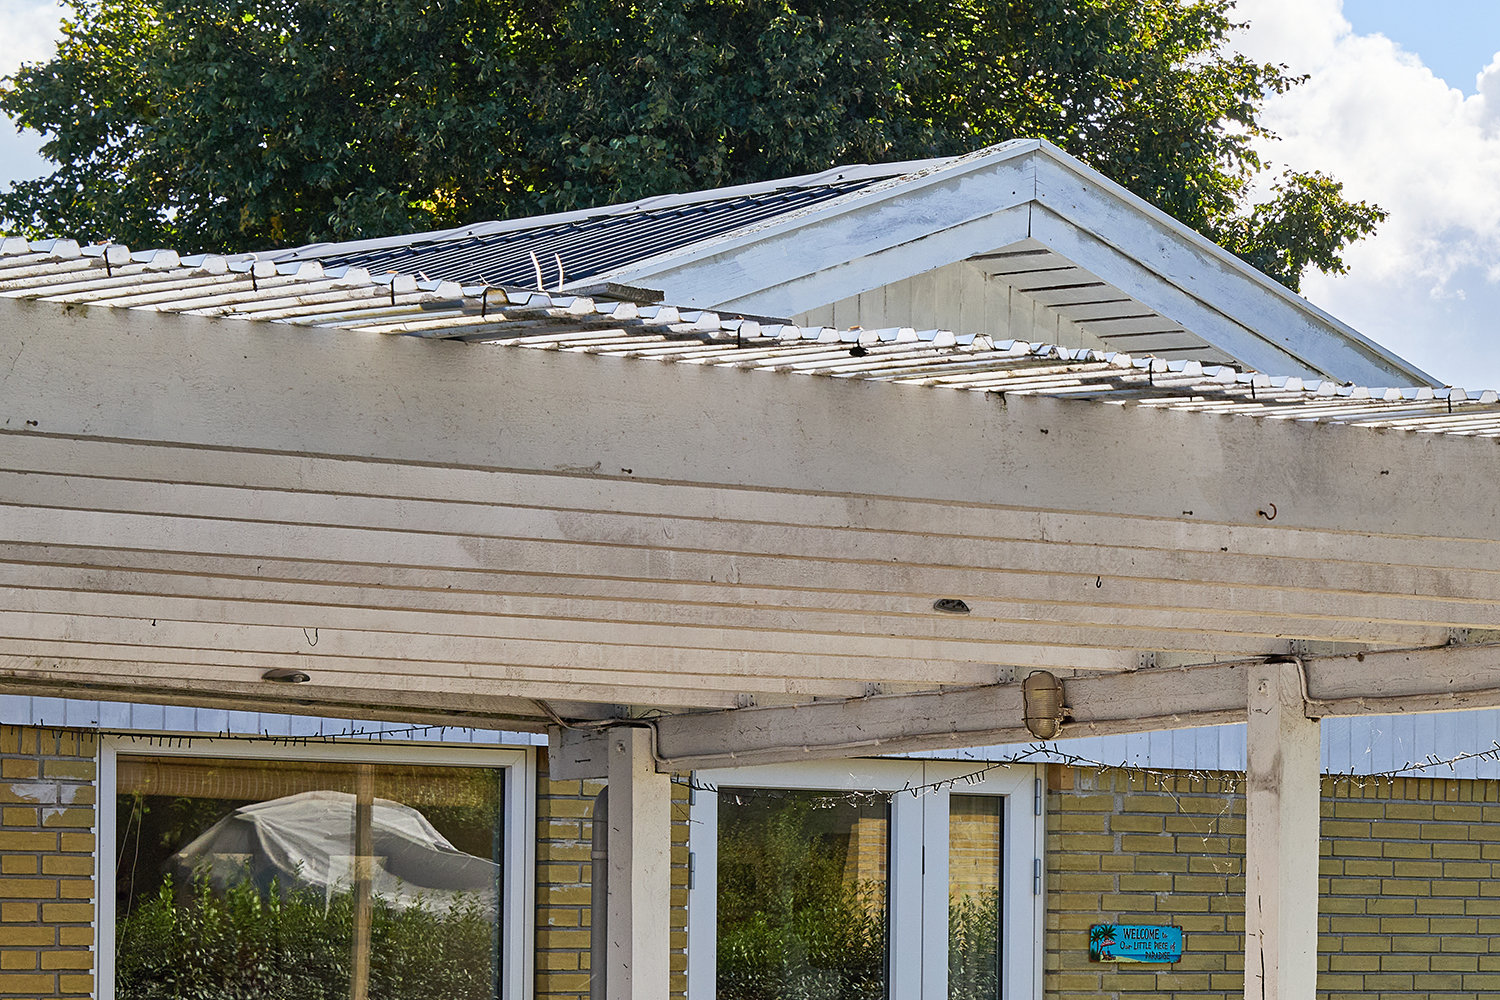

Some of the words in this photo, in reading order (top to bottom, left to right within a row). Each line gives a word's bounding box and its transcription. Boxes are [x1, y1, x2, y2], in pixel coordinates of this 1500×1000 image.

[1123, 928, 1160, 940] WELCOME
[1133, 941, 1152, 950] LITTLE
[1153, 941, 1168, 950] PIECE
[1144, 951, 1170, 960] PARADISE
